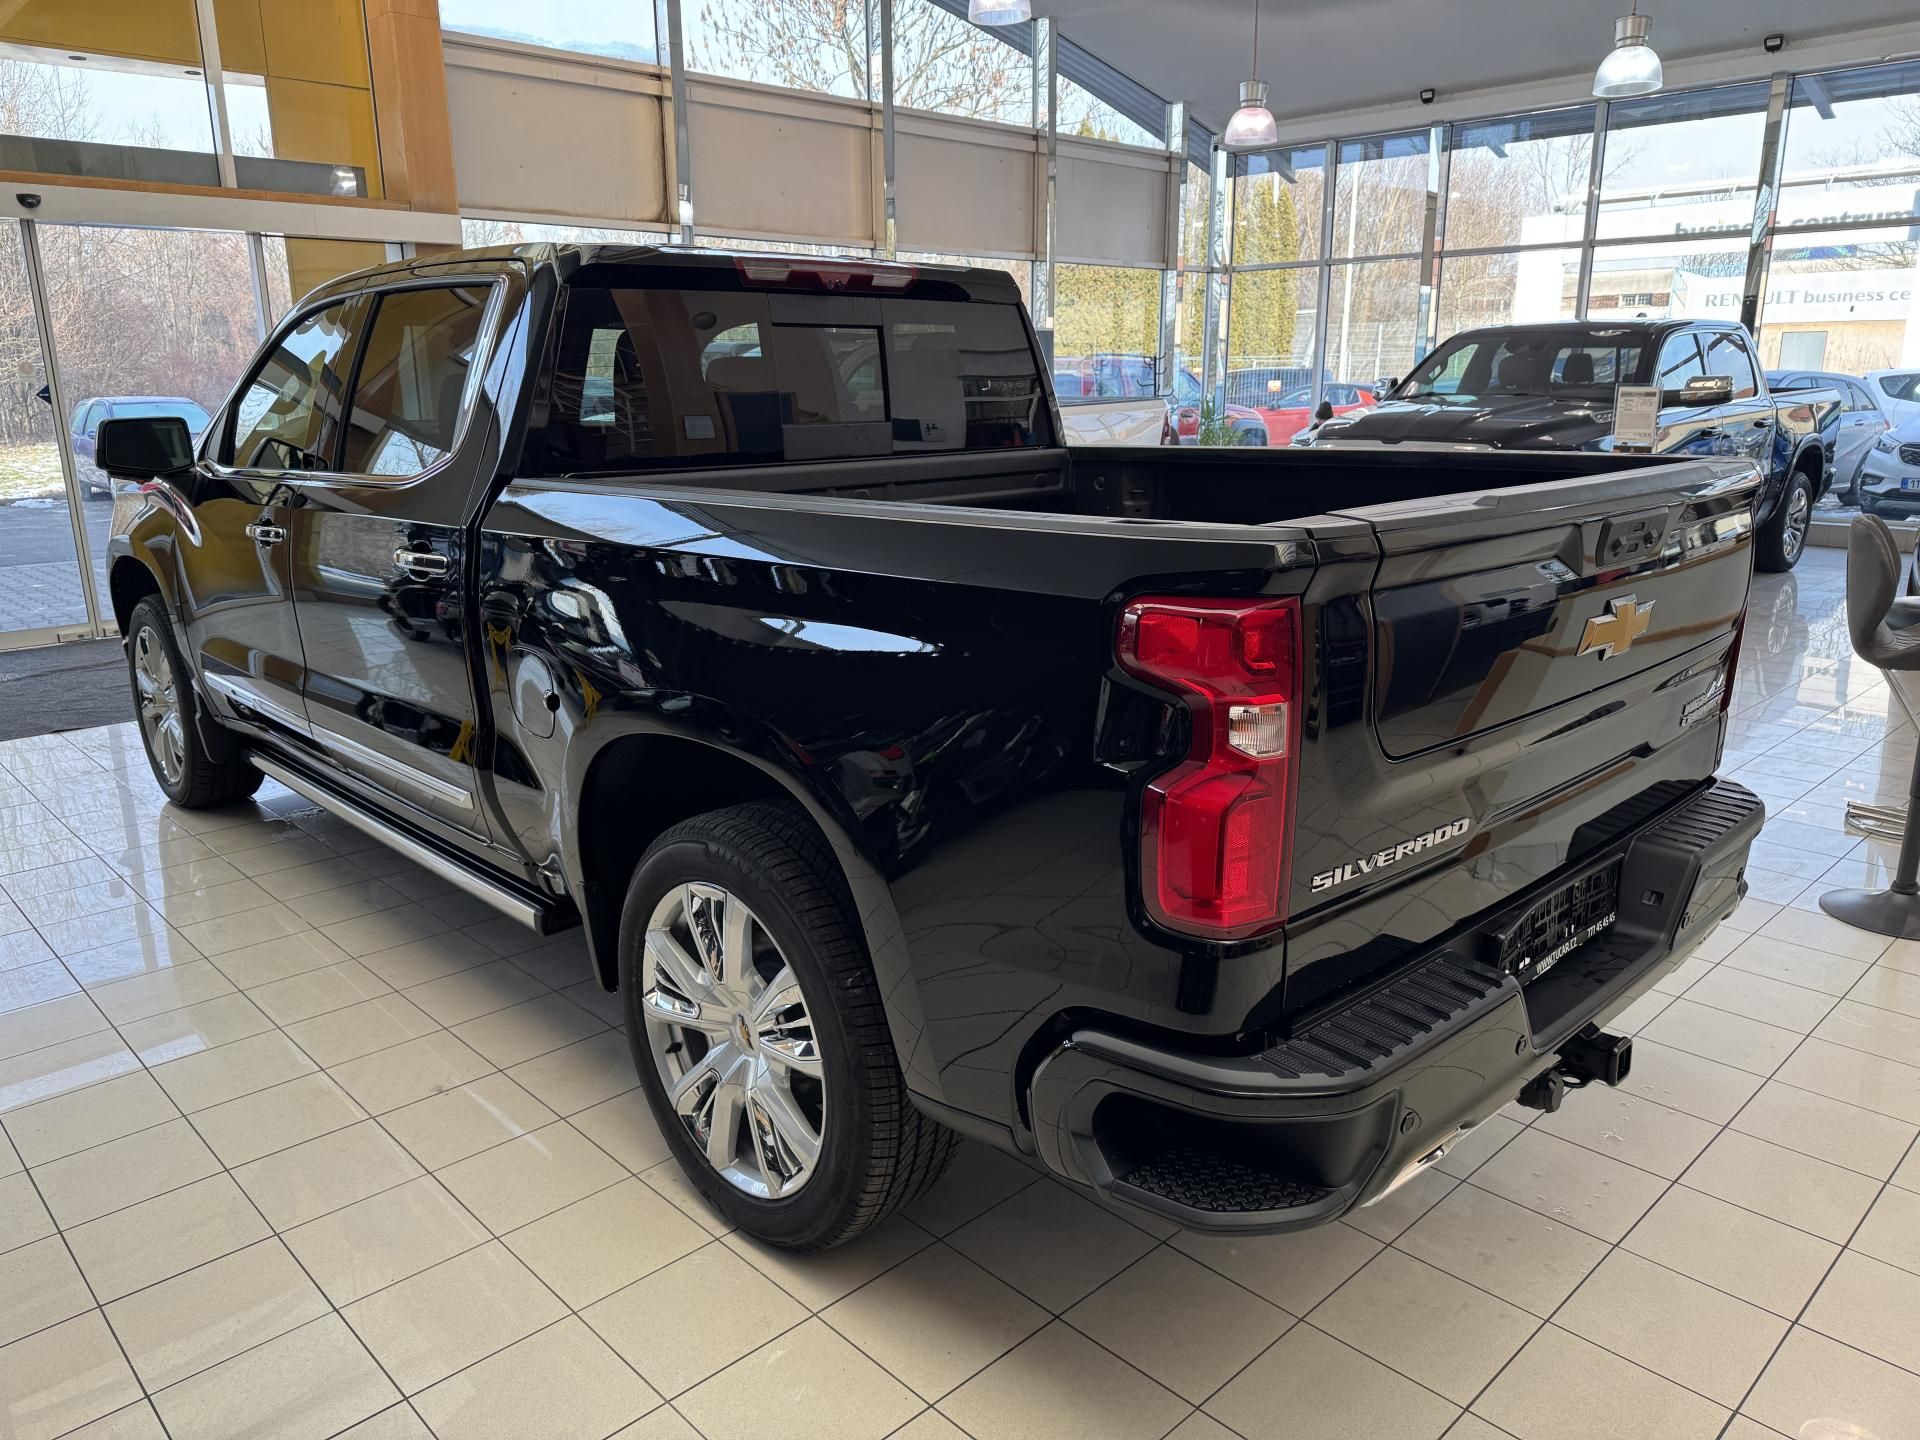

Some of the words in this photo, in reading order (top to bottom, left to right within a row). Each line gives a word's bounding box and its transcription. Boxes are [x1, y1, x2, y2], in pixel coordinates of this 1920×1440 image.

[1705, 289, 1800, 307] RENULT
[1804, 290, 1884, 304] business
[1889, 289, 1912, 301] ce
[1311, 817, 1470, 893] SILVERADO
